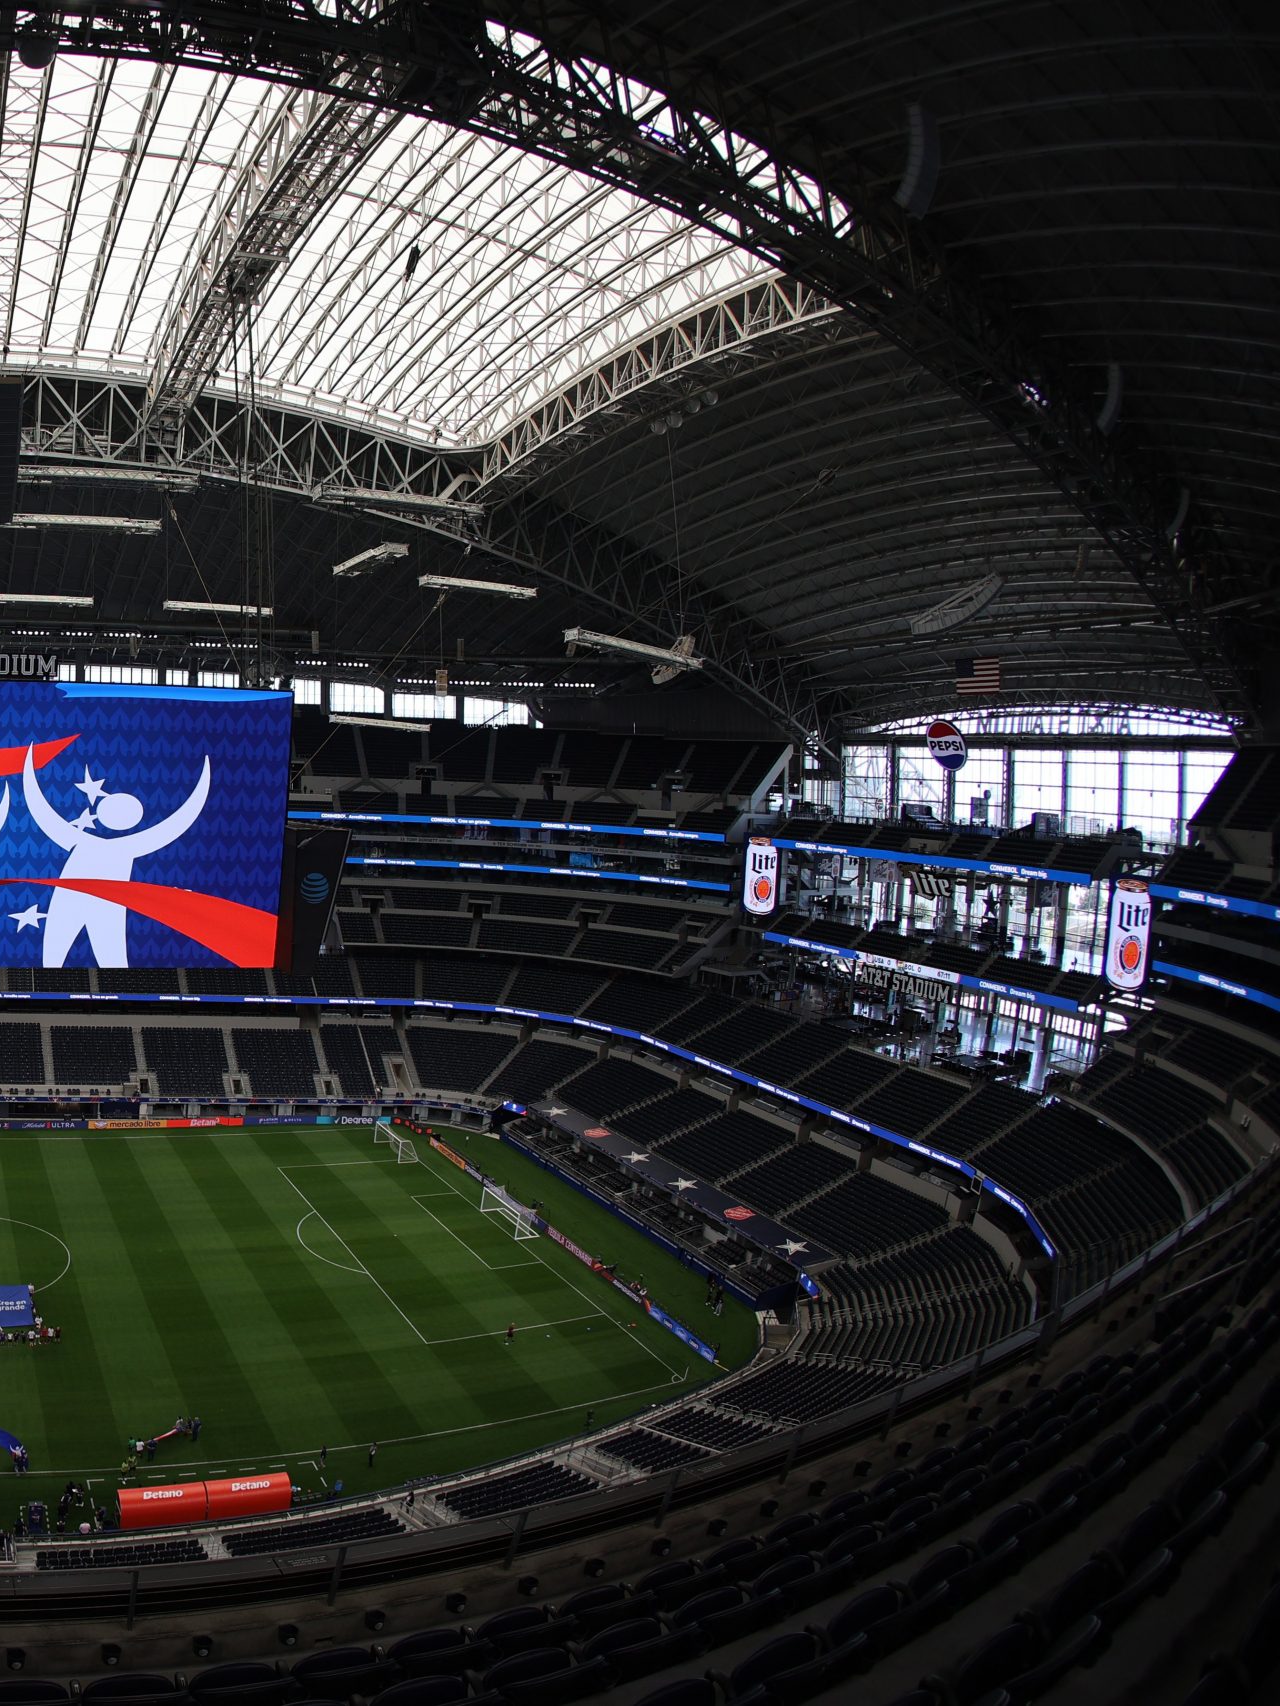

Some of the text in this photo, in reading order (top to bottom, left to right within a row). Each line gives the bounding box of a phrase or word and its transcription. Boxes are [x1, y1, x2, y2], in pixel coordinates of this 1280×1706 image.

[929, 740, 963, 752] PEPSI
[751, 852, 776, 874] Lite
[909, 871, 951, 901] Lite
[1117, 901, 1150, 932] Lite
[873, 956, 884, 965] USA
[904, 963, 914, 972] BOL
[860, 966, 950, 1003] AT&T STADIUM
[341, 1115, 373, 1125] Degree
[548, 1226, 592, 1267] TEQUILA CENTENARIO
[143, 1488, 183, 1500] Betano
[231, 1480, 270, 1492] Betano
